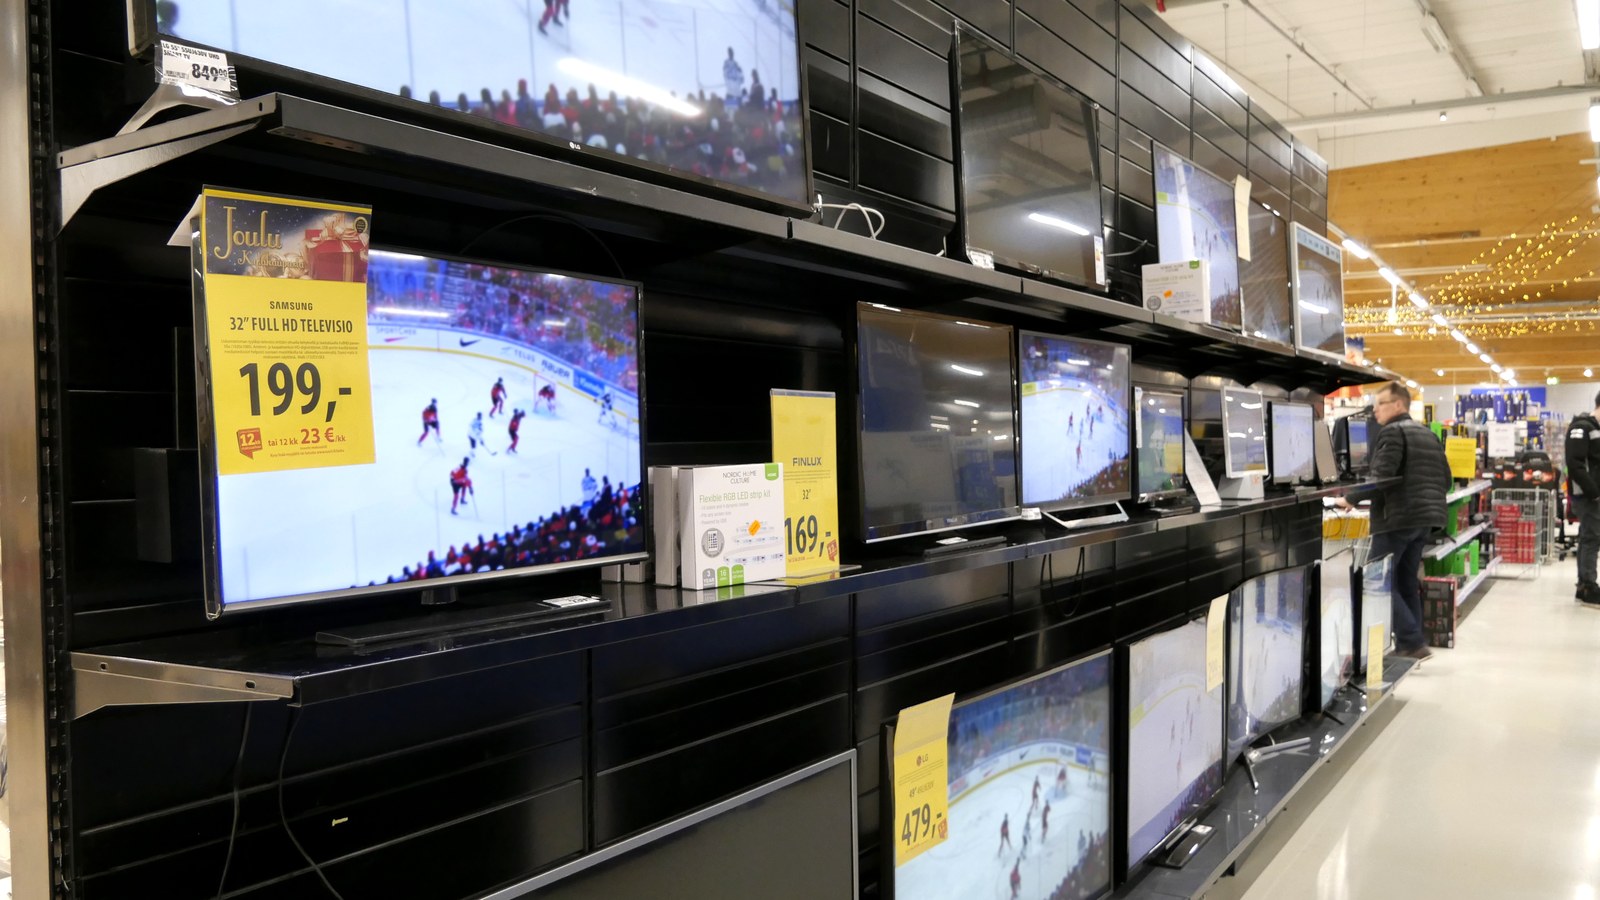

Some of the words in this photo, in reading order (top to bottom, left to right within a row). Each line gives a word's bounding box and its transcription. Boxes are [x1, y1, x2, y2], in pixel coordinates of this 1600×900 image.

[214, 206, 282, 260] Joulu
[270, 300, 314, 310] SAMSUNG
[252, 317, 280, 332] FULL
[282, 318, 298, 332] HD
[300, 319, 353, 333] TELEVISIO
[240, 362, 352, 423] 199,-
[289, 437, 298, 446] kk
[300, 428, 320, 444] 23
[792, 457, 822, 467] FINLUX
[700, 494, 722, 503] Flexible
[724, 492, 736, 501] RGB
[737, 491, 749, 500] LED
[750, 490, 762, 499] strip
[922, 754, 929, 763] LG
[902, 803, 942, 846] 479,-
